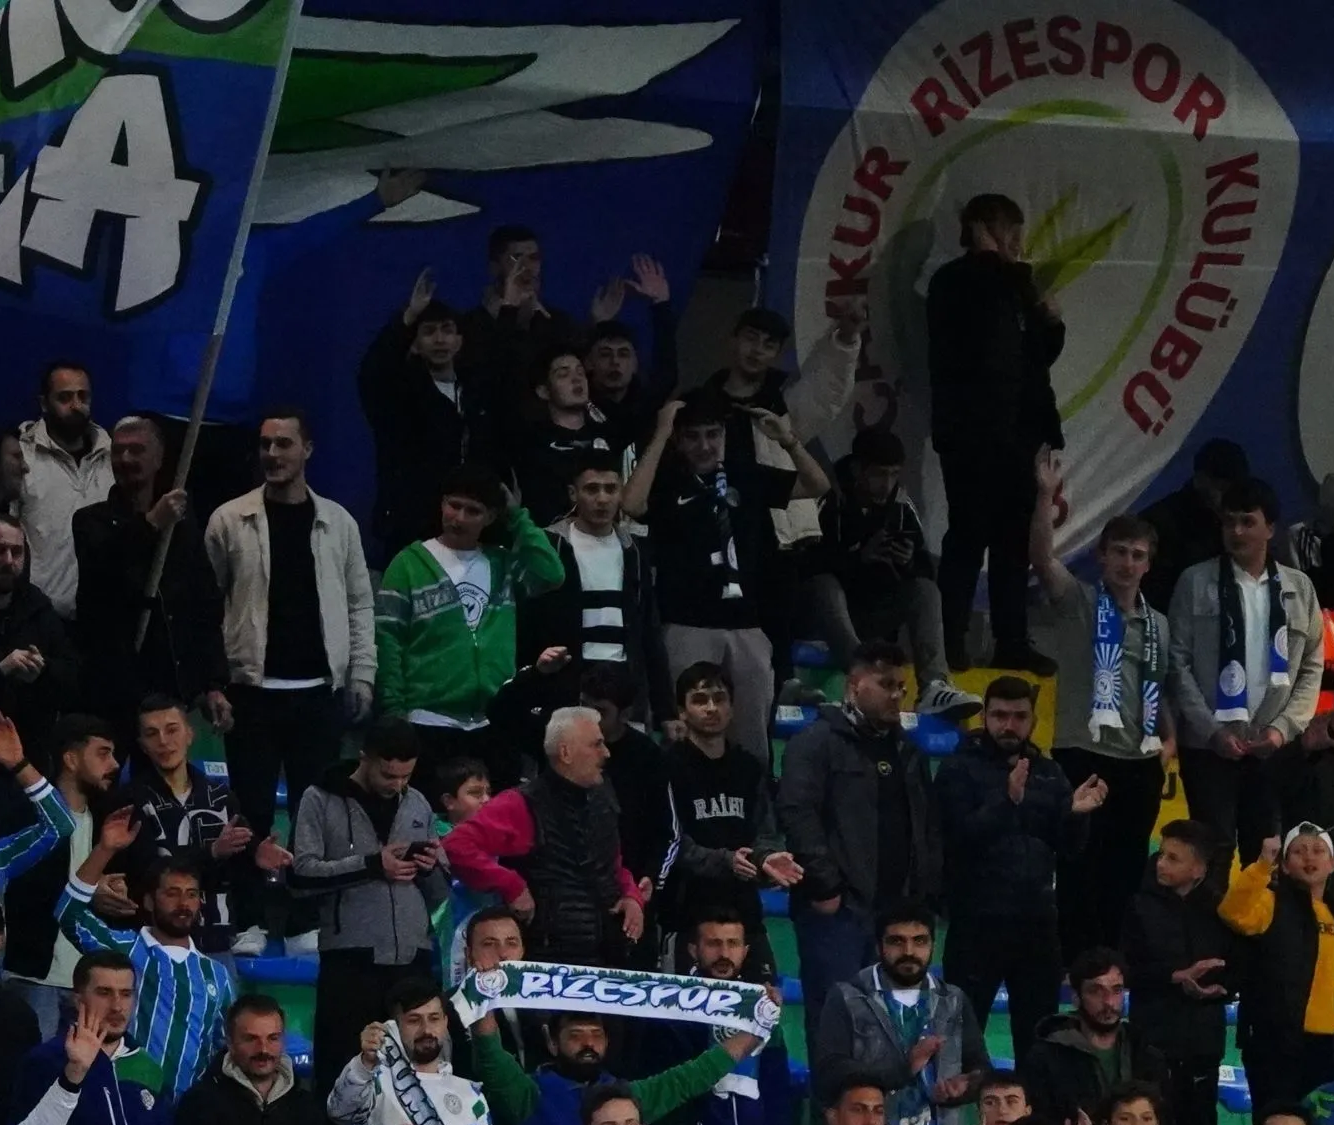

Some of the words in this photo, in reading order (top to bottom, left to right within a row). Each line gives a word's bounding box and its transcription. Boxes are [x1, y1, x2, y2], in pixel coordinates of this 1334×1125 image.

[910, 15, 1227, 143] RİZESPOR
[1122, 151, 1261, 437] KULÜBÜ
[520, 967, 743, 1018] RİZESPOR
